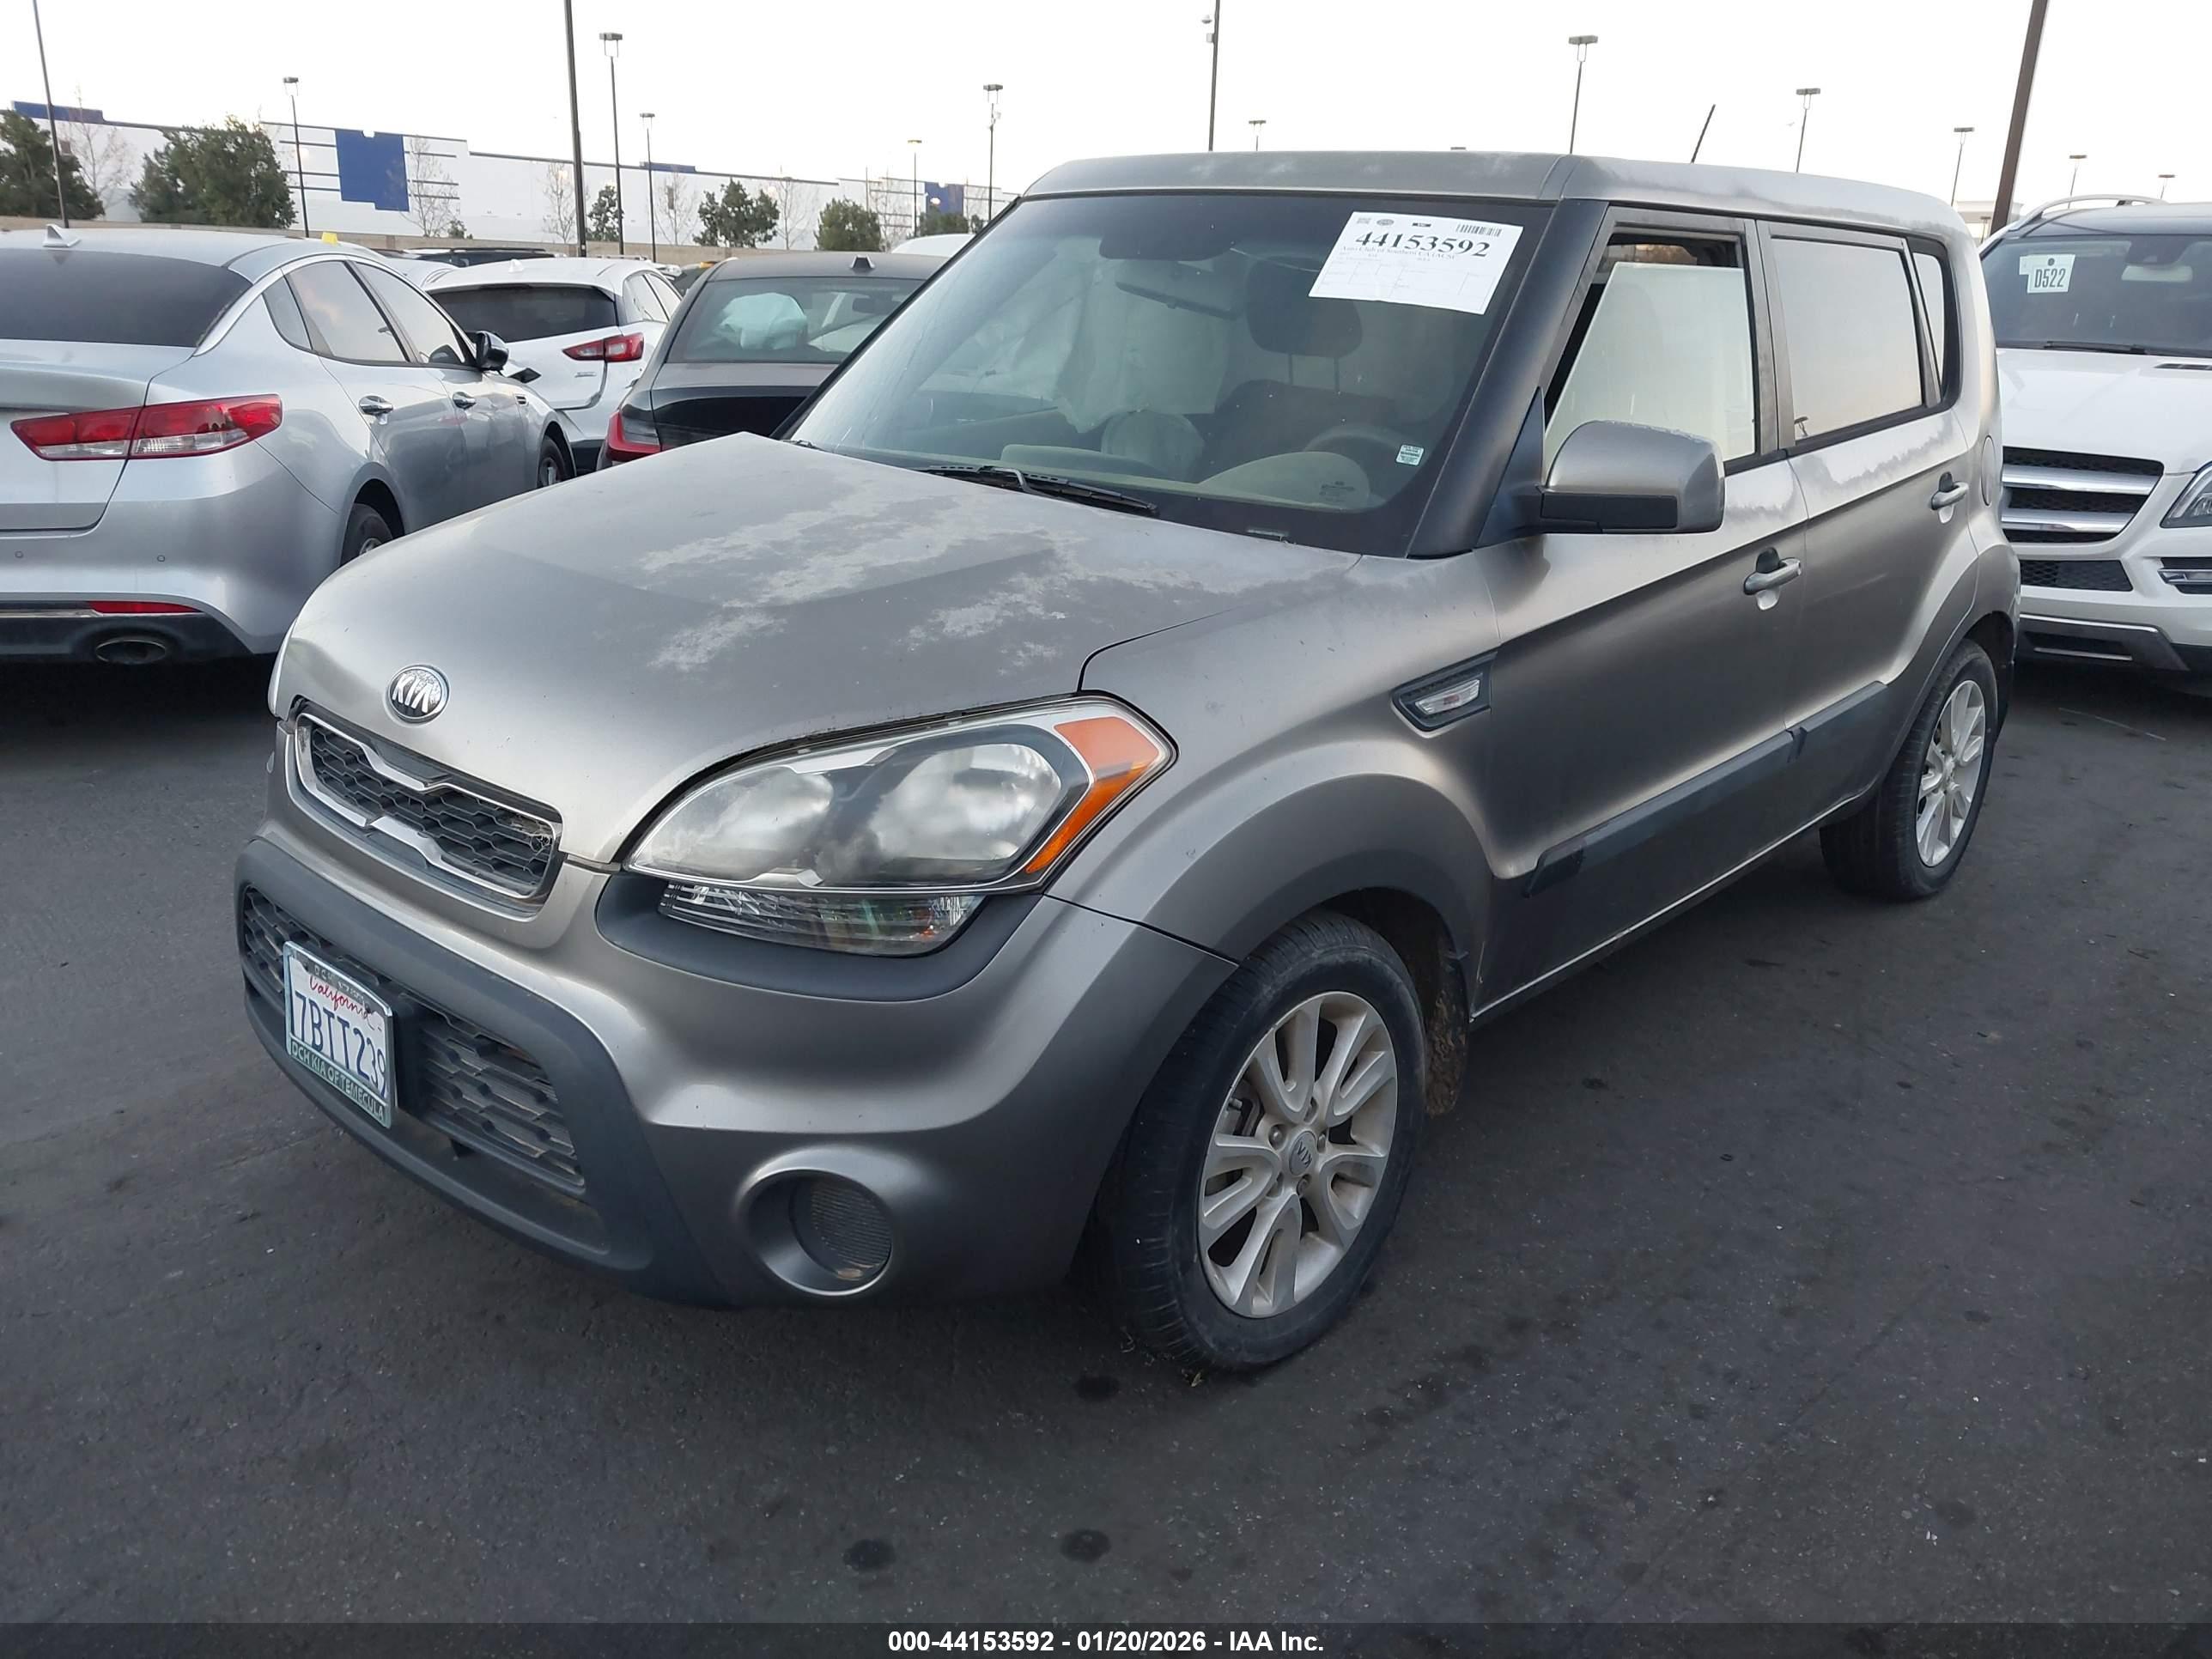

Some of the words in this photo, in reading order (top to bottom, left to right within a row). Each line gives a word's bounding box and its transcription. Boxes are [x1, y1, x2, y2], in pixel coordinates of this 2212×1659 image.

[1356, 232, 1490, 257] 44153592
[2034, 268, 2066, 288] D522
[309, 975, 371, 1019] California
[295, 993, 387, 1098] 7BTT239
[292, 1041, 310, 1063] DCH
[312, 1054, 326, 1078] KIA
[327, 1067, 337, 1086] OF
[337, 1071, 384, 1121] TEMECULA
